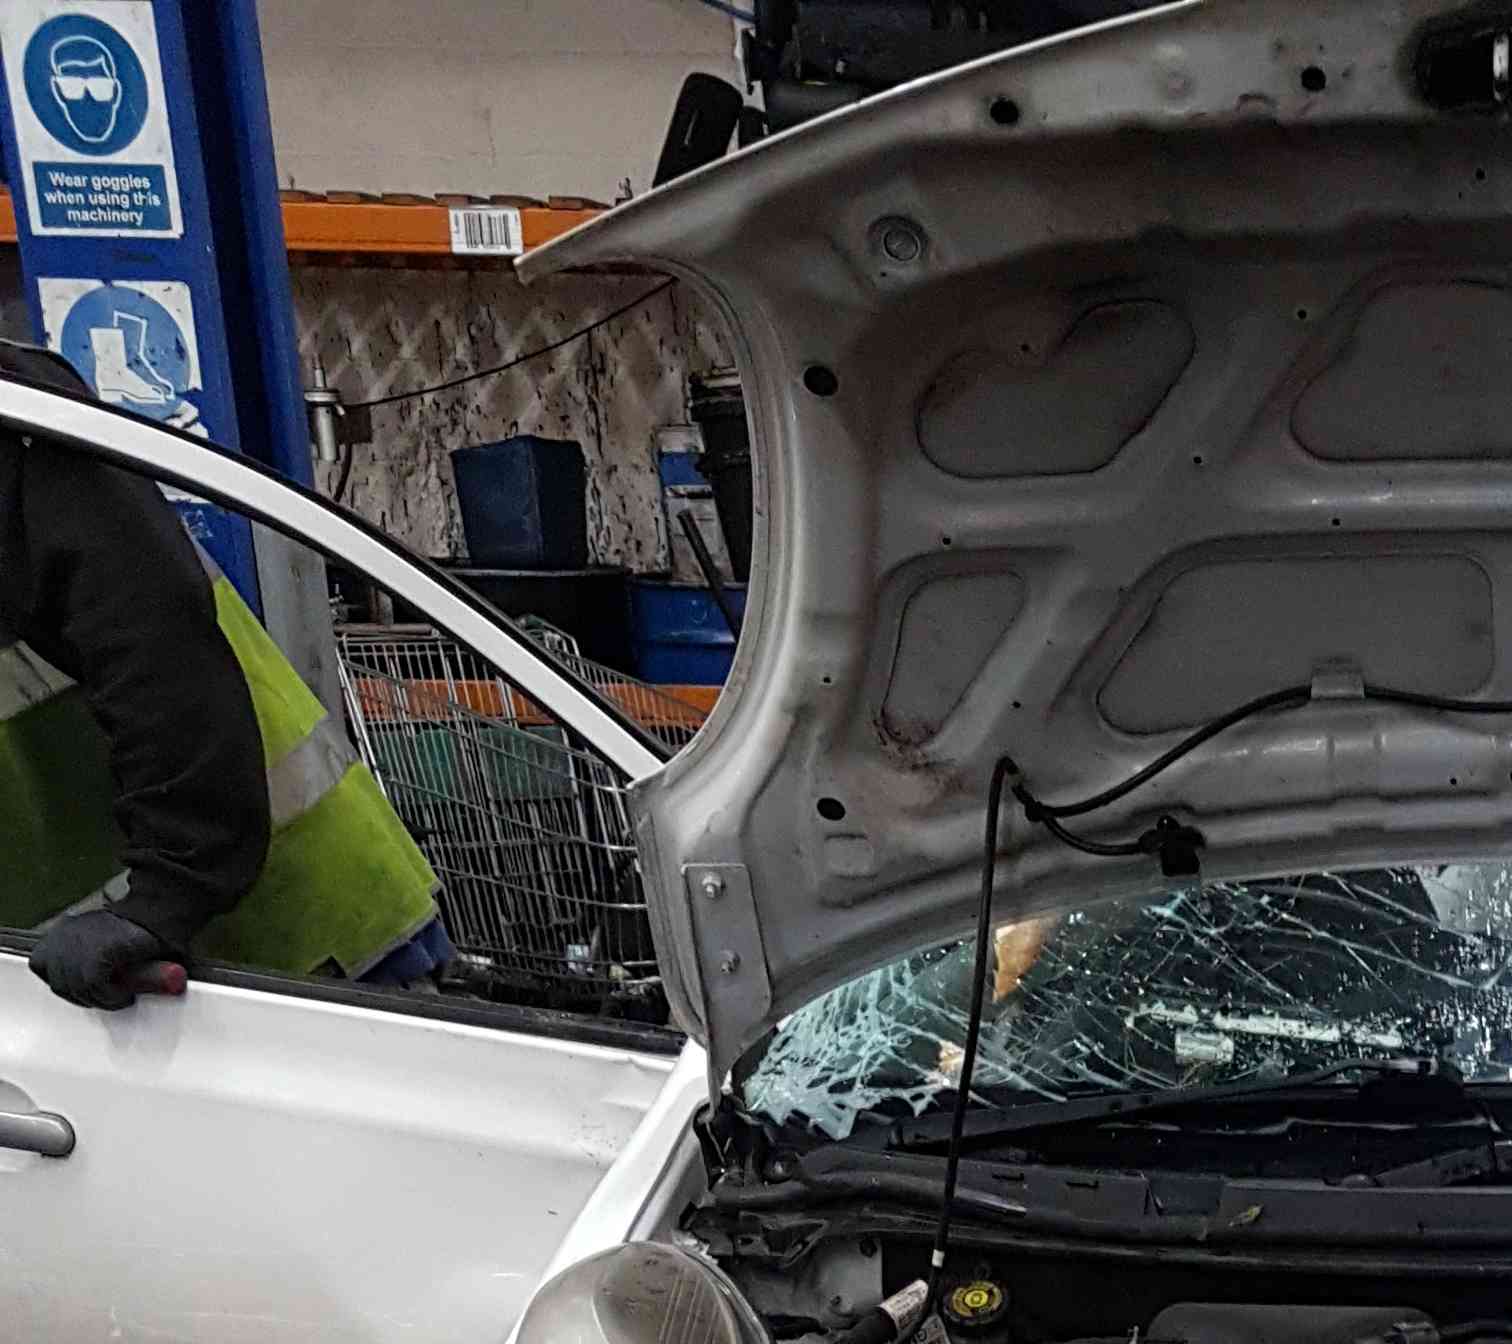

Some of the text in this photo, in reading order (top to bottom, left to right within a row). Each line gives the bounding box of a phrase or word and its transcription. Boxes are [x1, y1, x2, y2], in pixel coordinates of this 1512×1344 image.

[48, 171, 151, 191] Wear goggles
[44, 190, 161, 209] when using this
[67, 206, 144, 226] machinery
